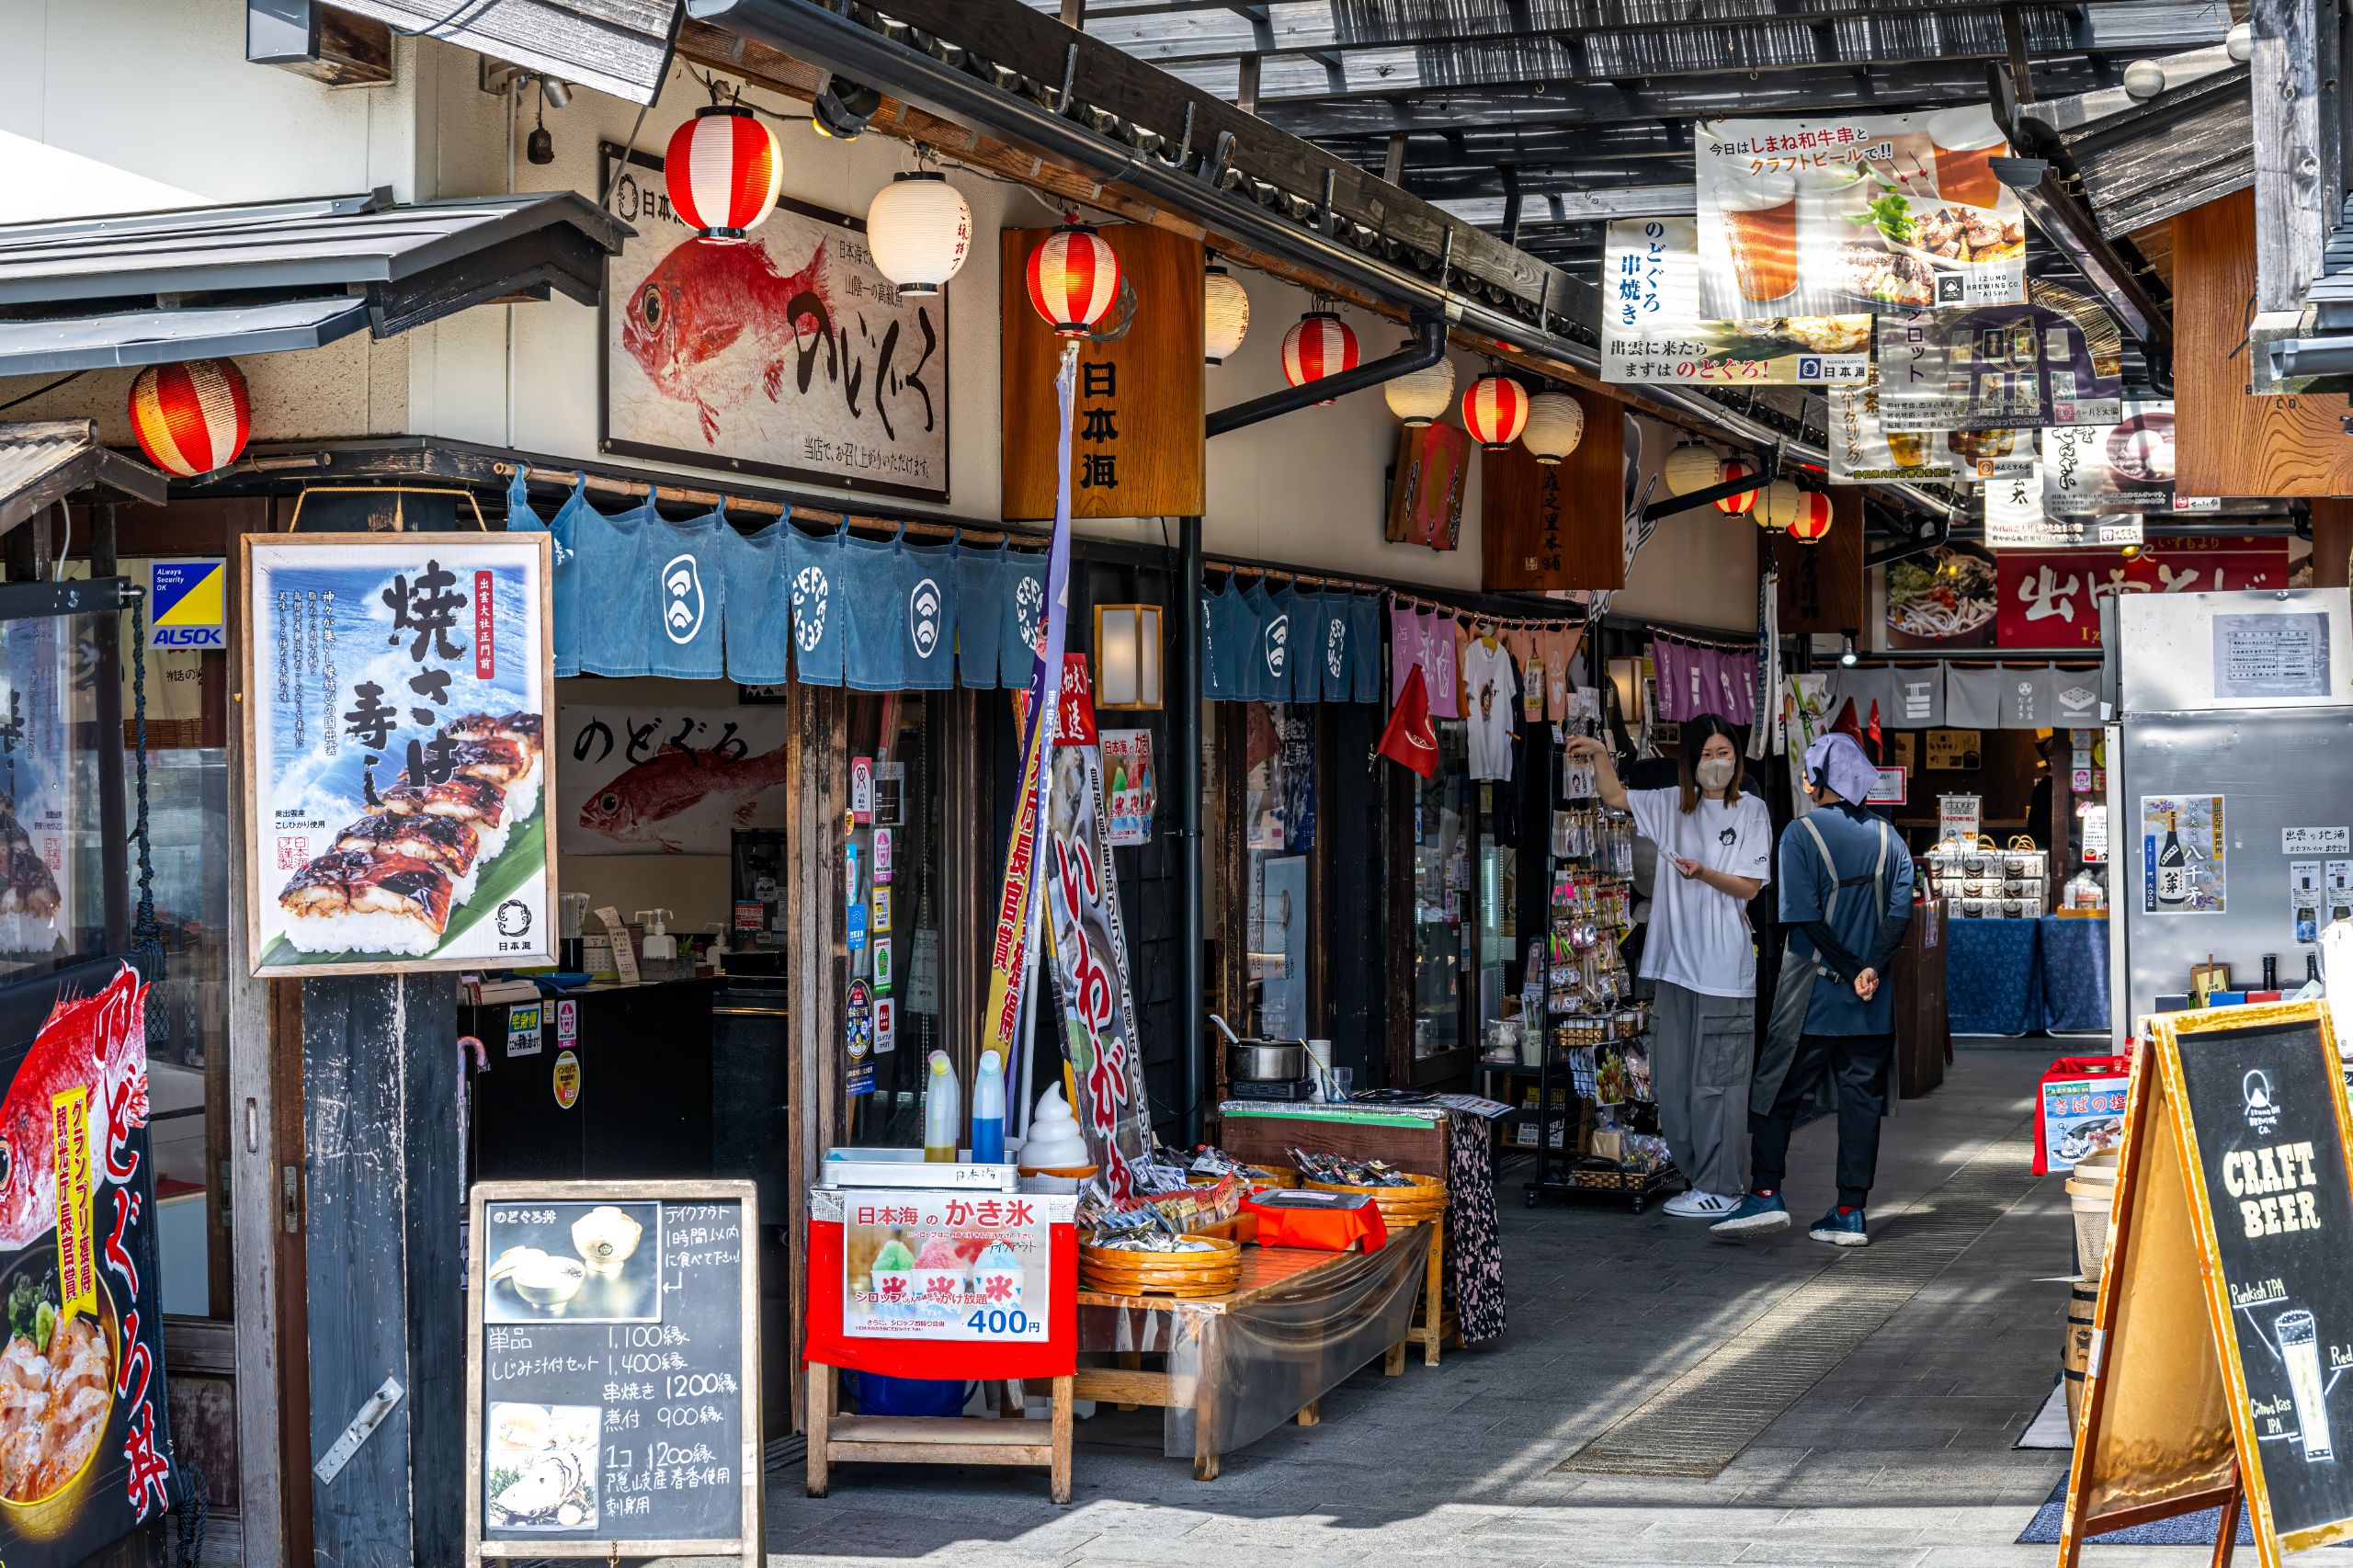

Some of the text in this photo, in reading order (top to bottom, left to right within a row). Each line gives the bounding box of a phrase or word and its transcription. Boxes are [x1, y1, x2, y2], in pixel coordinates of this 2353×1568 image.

[1710, 127, 1868, 156] 今日はしまね和牛串と
[642, 188, 685, 226] 日本
[1643, 221, 1665, 312] のどぐろ
[1620, 254, 1642, 324] 串焼き
[1967, 282, 2006, 290] BREWING
[1610, 340, 1708, 356] 出雲に来たら
[787, 290, 936, 441] のどぐろ
[1824, 367, 1865, 378] 日本海
[1081, 361, 1120, 489] 日本海
[1841, 384, 1864, 464] パークリング
[1541, 463, 1563, 572] 在之里本舗
[156, 576, 185, 585] Security
[153, 628, 222, 645] ALSOK
[479, 578, 491, 671] 出雲大社正門前
[322, 590, 337, 756] 神々が集いし縁結びの国出雲
[381, 559, 468, 789] 焼さば
[344, 680, 397, 808] 寿し
[573, 715, 748, 767] のどぐろ
[1104, 739, 1127, 755] 日本海
[275, 810, 306, 819] 奥出雲産
[275, 820, 325, 830] こしひかり使用
[2286, 829, 2345, 841] 出雲の地酒
[2183, 845, 2204, 906] 八千矛
[499, 942, 532, 951] 日本海
[2222, 1141, 2317, 1199] CRAFT
[56, 1106, 77, 1301] 観光庁長官賞
[72, 1098, 94, 1296] グランプリ獲得
[493, 1210, 557, 1224] のどぐろ丼
[665, 1206, 730, 1225] テイクアウト
[857, 1199, 1036, 1227] 日本海 の かき氷
[2240, 1191, 2322, 1238] BEER
[665, 1226, 740, 1248] 1時間以内
[855, 1290, 906, 1303] シロップ
[939, 1292, 988, 1305] かけ放題
[2266, 1278, 2286, 1298] IPA
[967, 1310, 1040, 1334] 400 円
[488, 1327, 533, 1351] 単品
[2330, 1345, 2353, 1367] Red
[602, 1382, 655, 1403] 串焼き
[2250, 1397, 2274, 1417] Citrus
[604, 1411, 641, 1434] 煮付
[2268, 1418, 2283, 1434] IPA
[605, 1468, 730, 1494] 隠岐産春香使用
[605, 1497, 651, 1517] 刺身用
